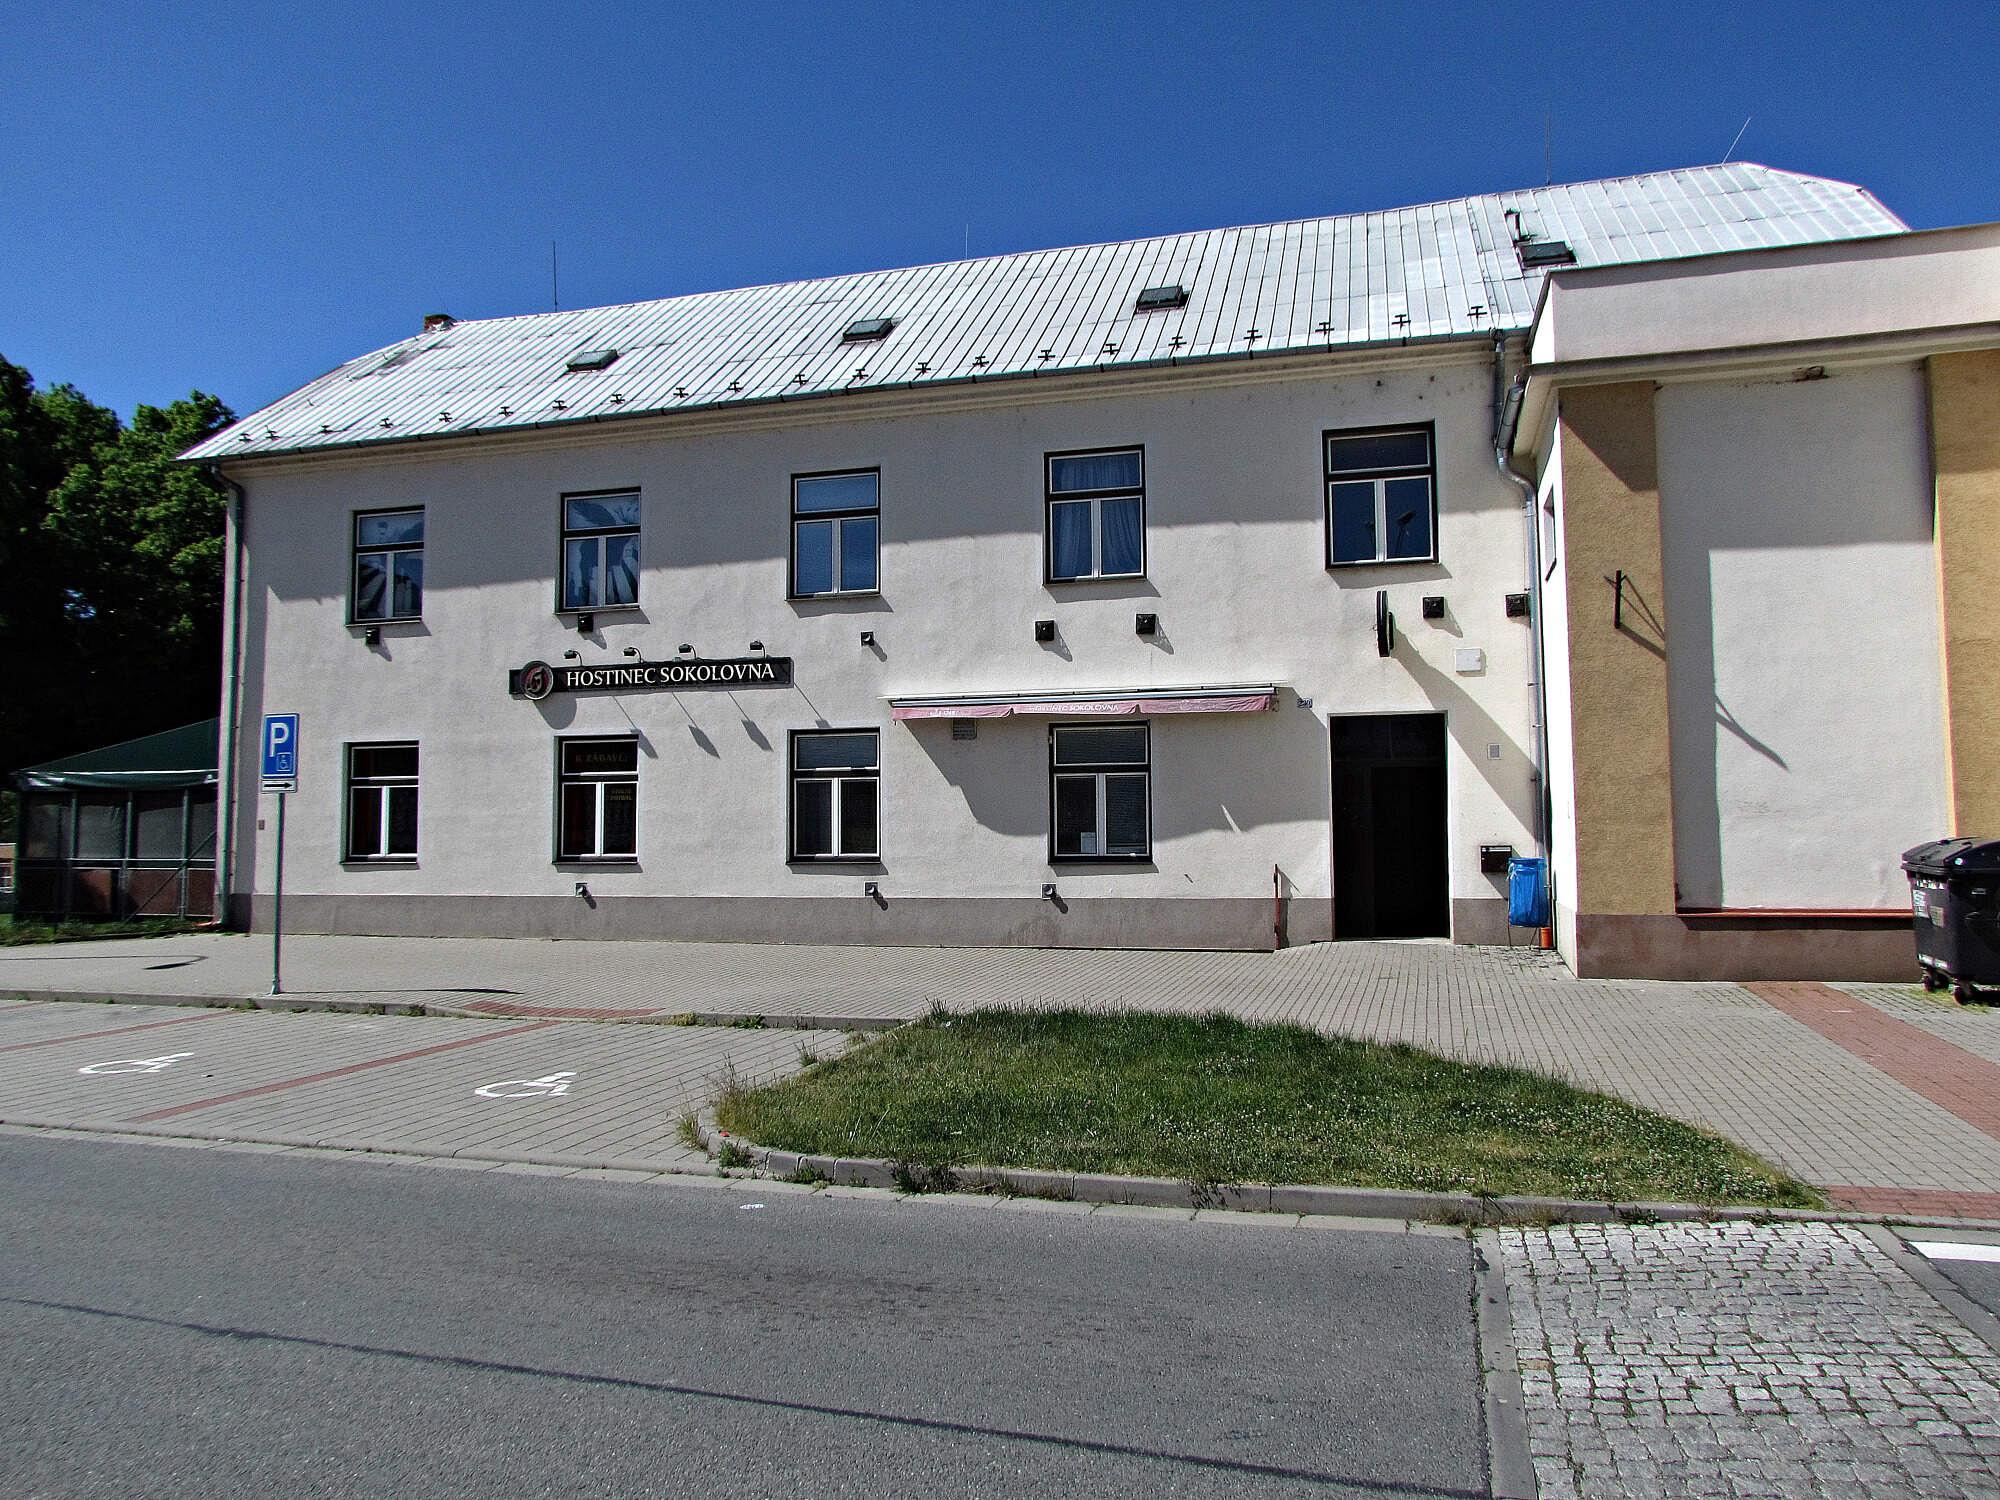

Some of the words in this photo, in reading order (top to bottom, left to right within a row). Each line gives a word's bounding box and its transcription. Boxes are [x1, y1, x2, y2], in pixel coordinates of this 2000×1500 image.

[566, 667, 656, 687] HOSTINEC
[660, 663, 775, 683] SOKOLOVNA
[269, 722, 290, 758] P
